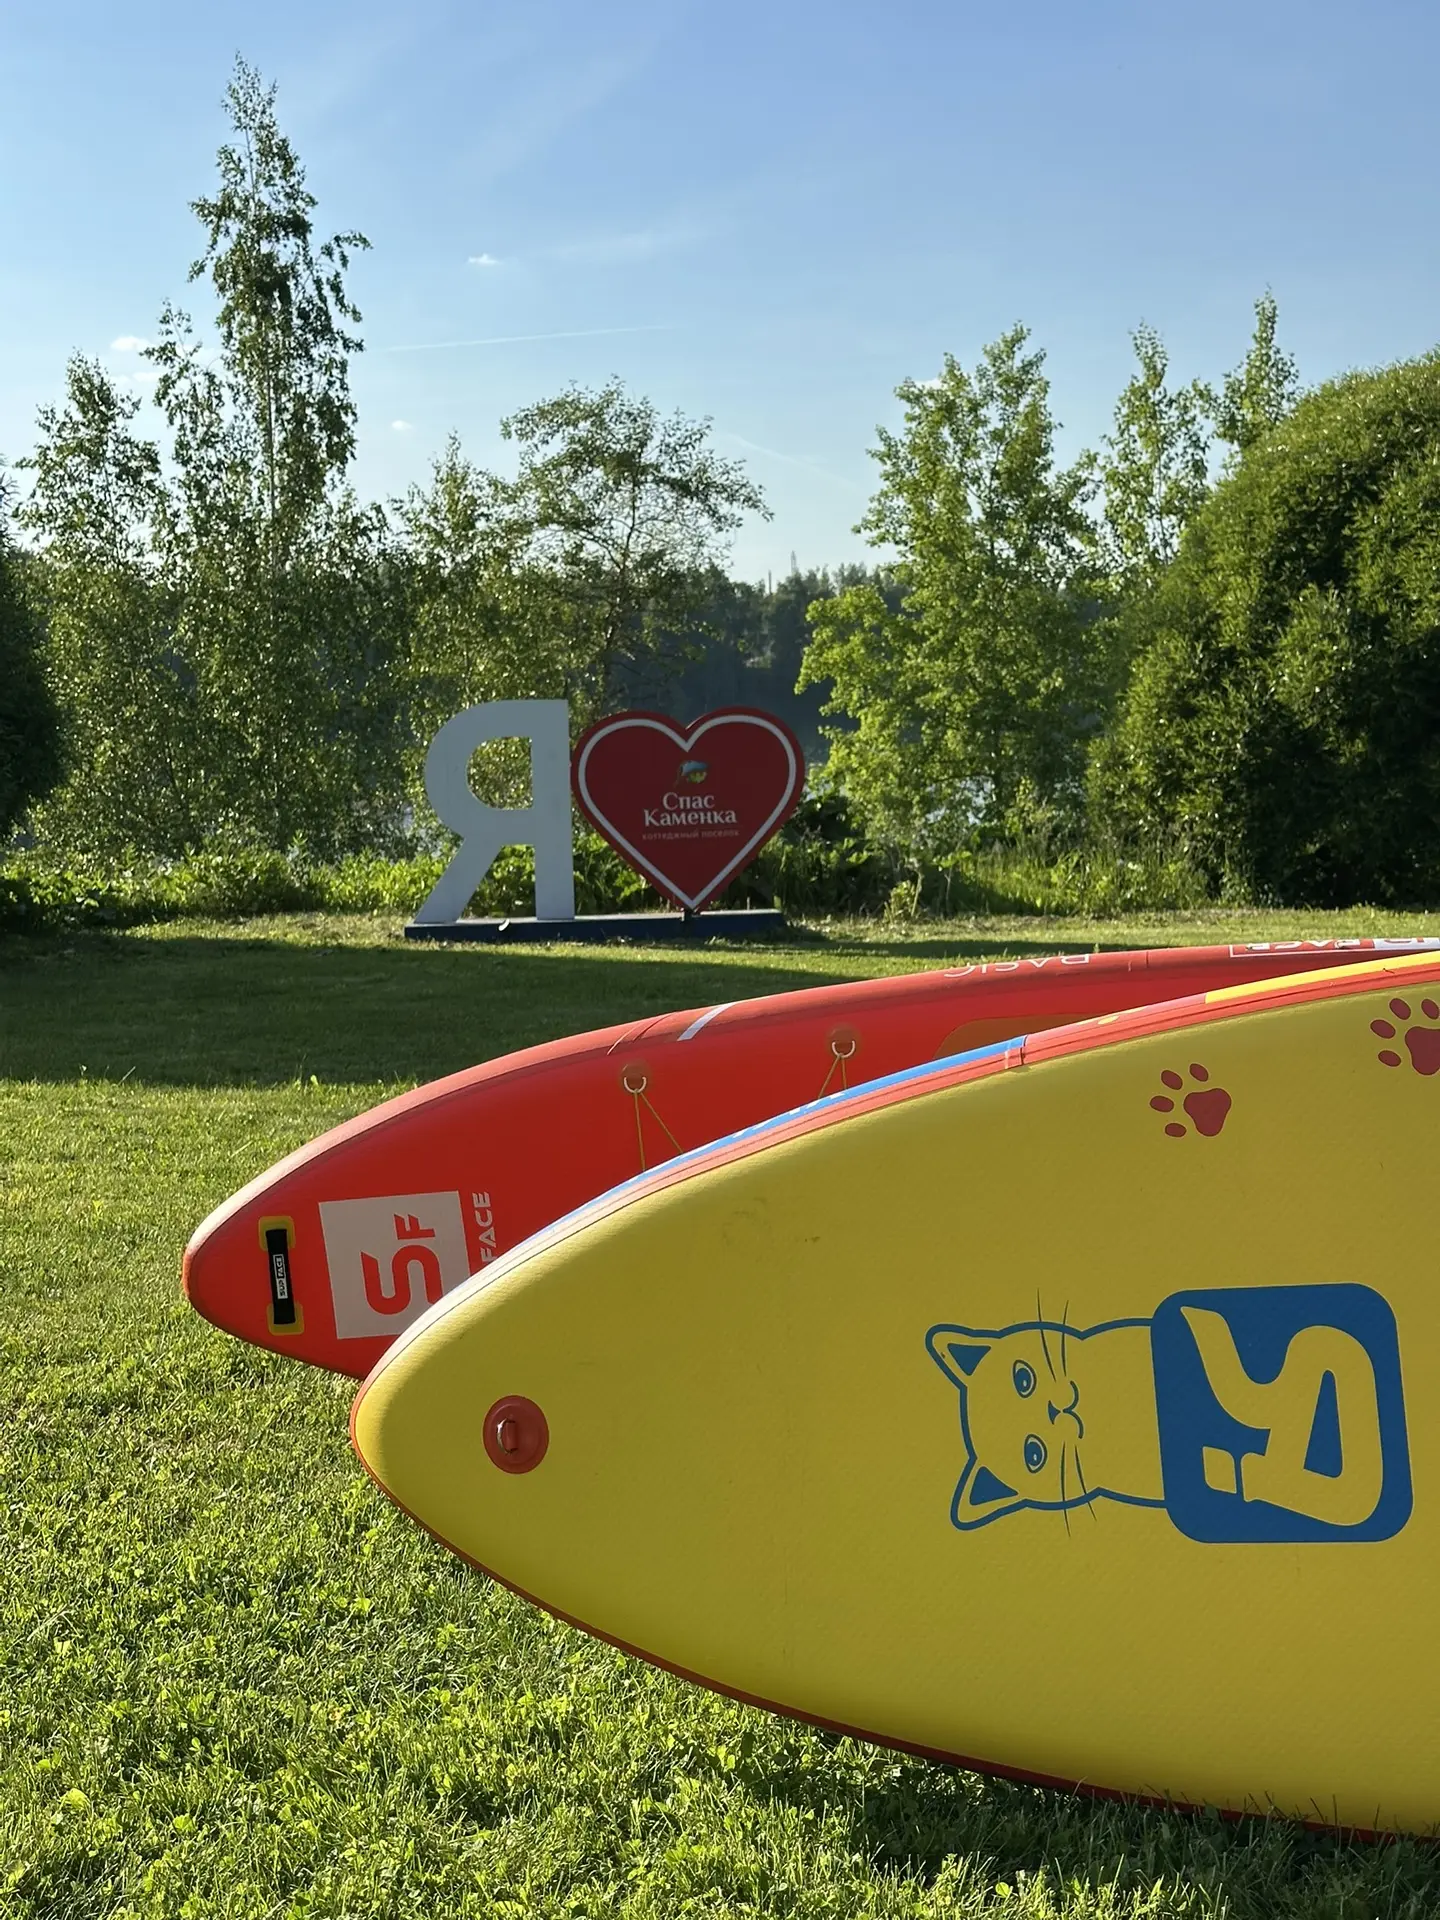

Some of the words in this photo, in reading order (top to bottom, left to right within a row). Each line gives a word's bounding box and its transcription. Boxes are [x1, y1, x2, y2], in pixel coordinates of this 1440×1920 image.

[662, 791, 716, 811] Спас
[415, 699, 575, 924] Я
[643, 809, 738, 827] Каменка
[472, 1191, 498, 1263] FACE
[276, 1257, 284, 1277] FACE
[278, 1279, 286, 1297] SUP
